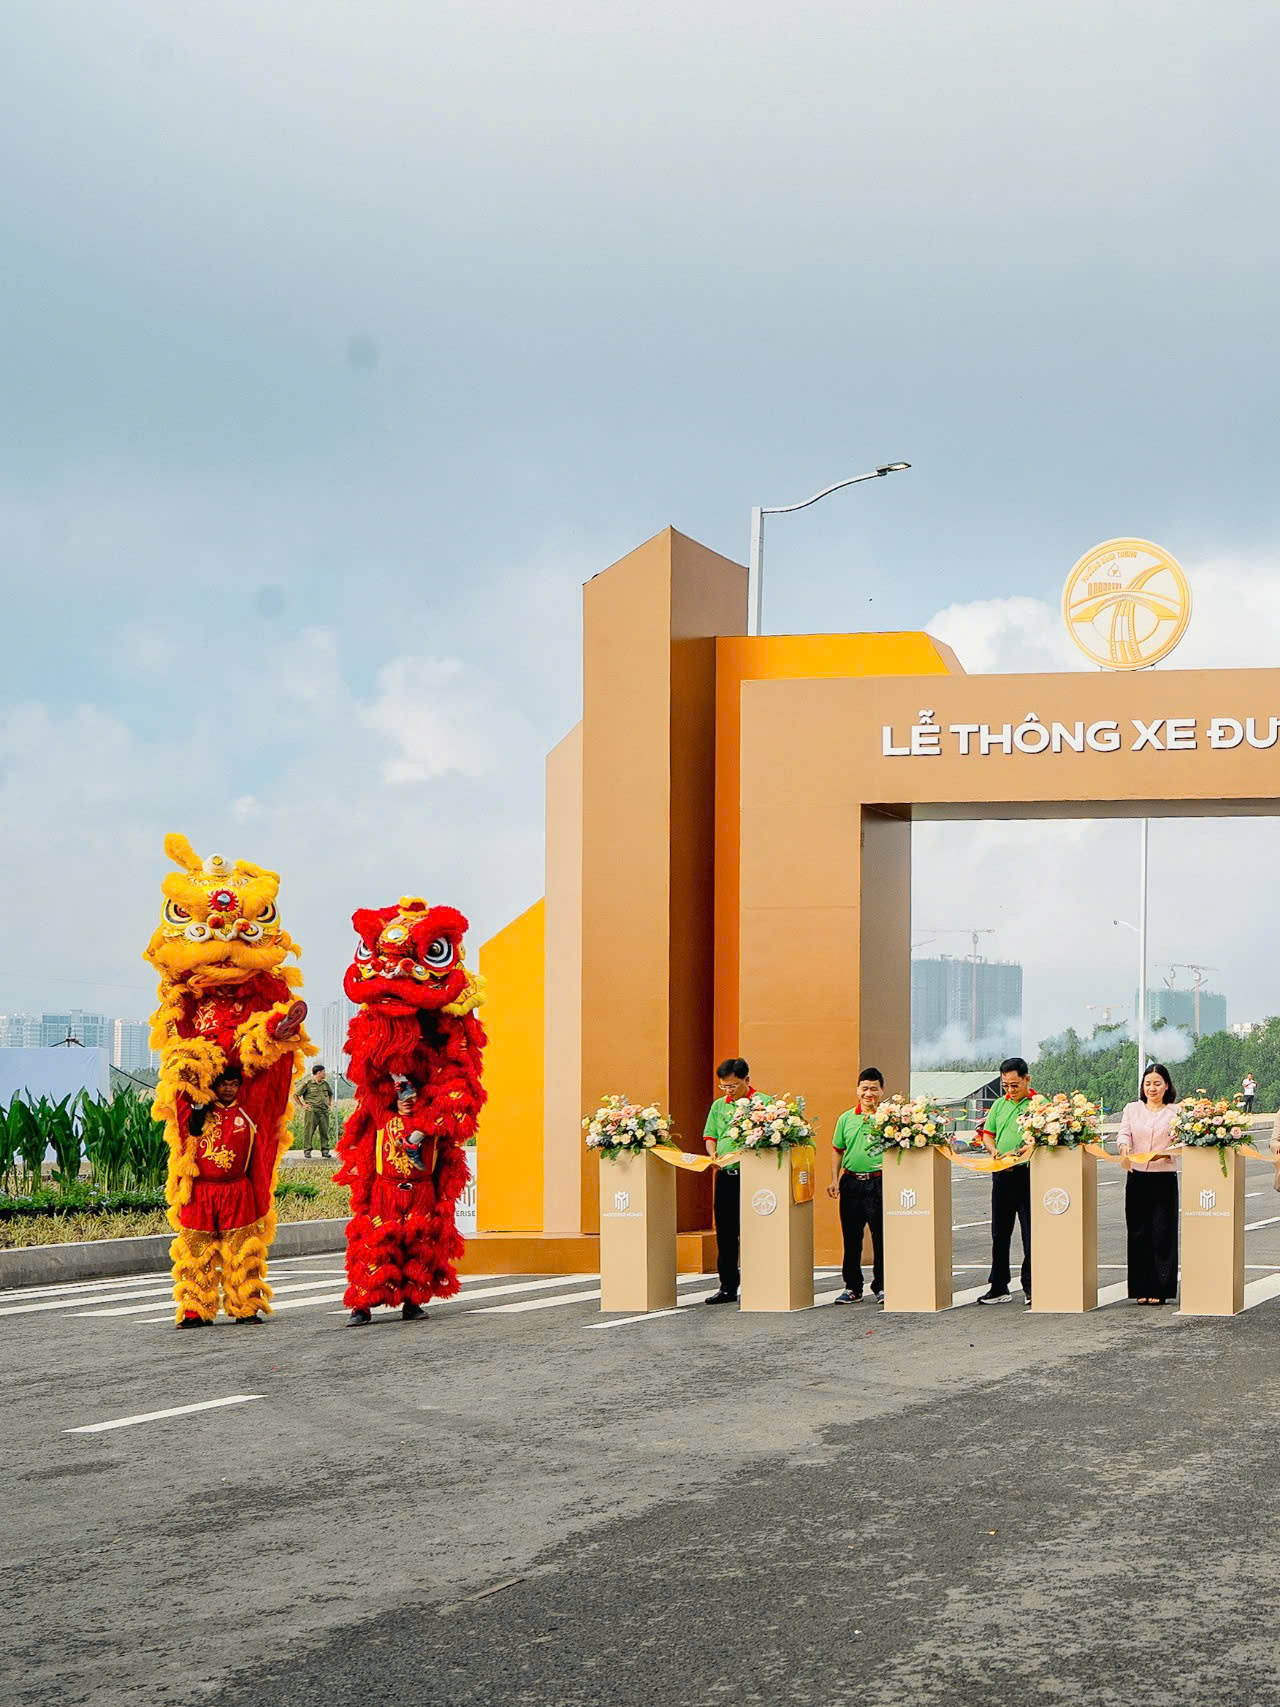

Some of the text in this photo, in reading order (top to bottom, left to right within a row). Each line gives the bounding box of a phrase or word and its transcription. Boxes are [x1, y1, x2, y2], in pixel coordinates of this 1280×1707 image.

[881, 709, 942, 757] LỄ
[948, 712, 1121, 756] THÔNG
[1130, 717, 1198, 751] XE
